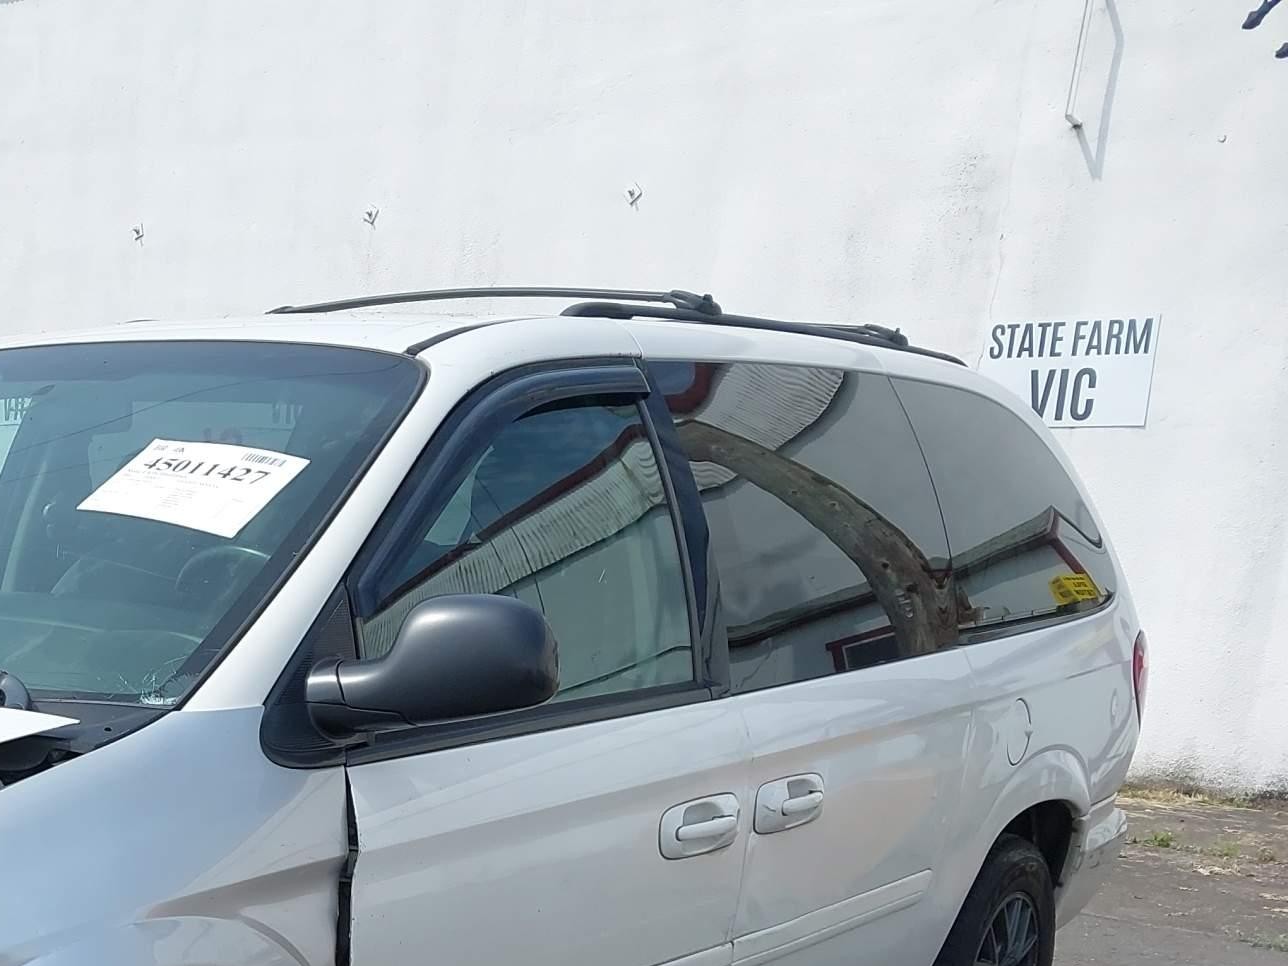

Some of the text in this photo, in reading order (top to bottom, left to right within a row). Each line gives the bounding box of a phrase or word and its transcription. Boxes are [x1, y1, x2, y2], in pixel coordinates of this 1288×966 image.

[989, 318, 1154, 360] STATE FARM
[1030, 367, 1097, 421] VIC
[143, 456, 272, 485] 45011427
